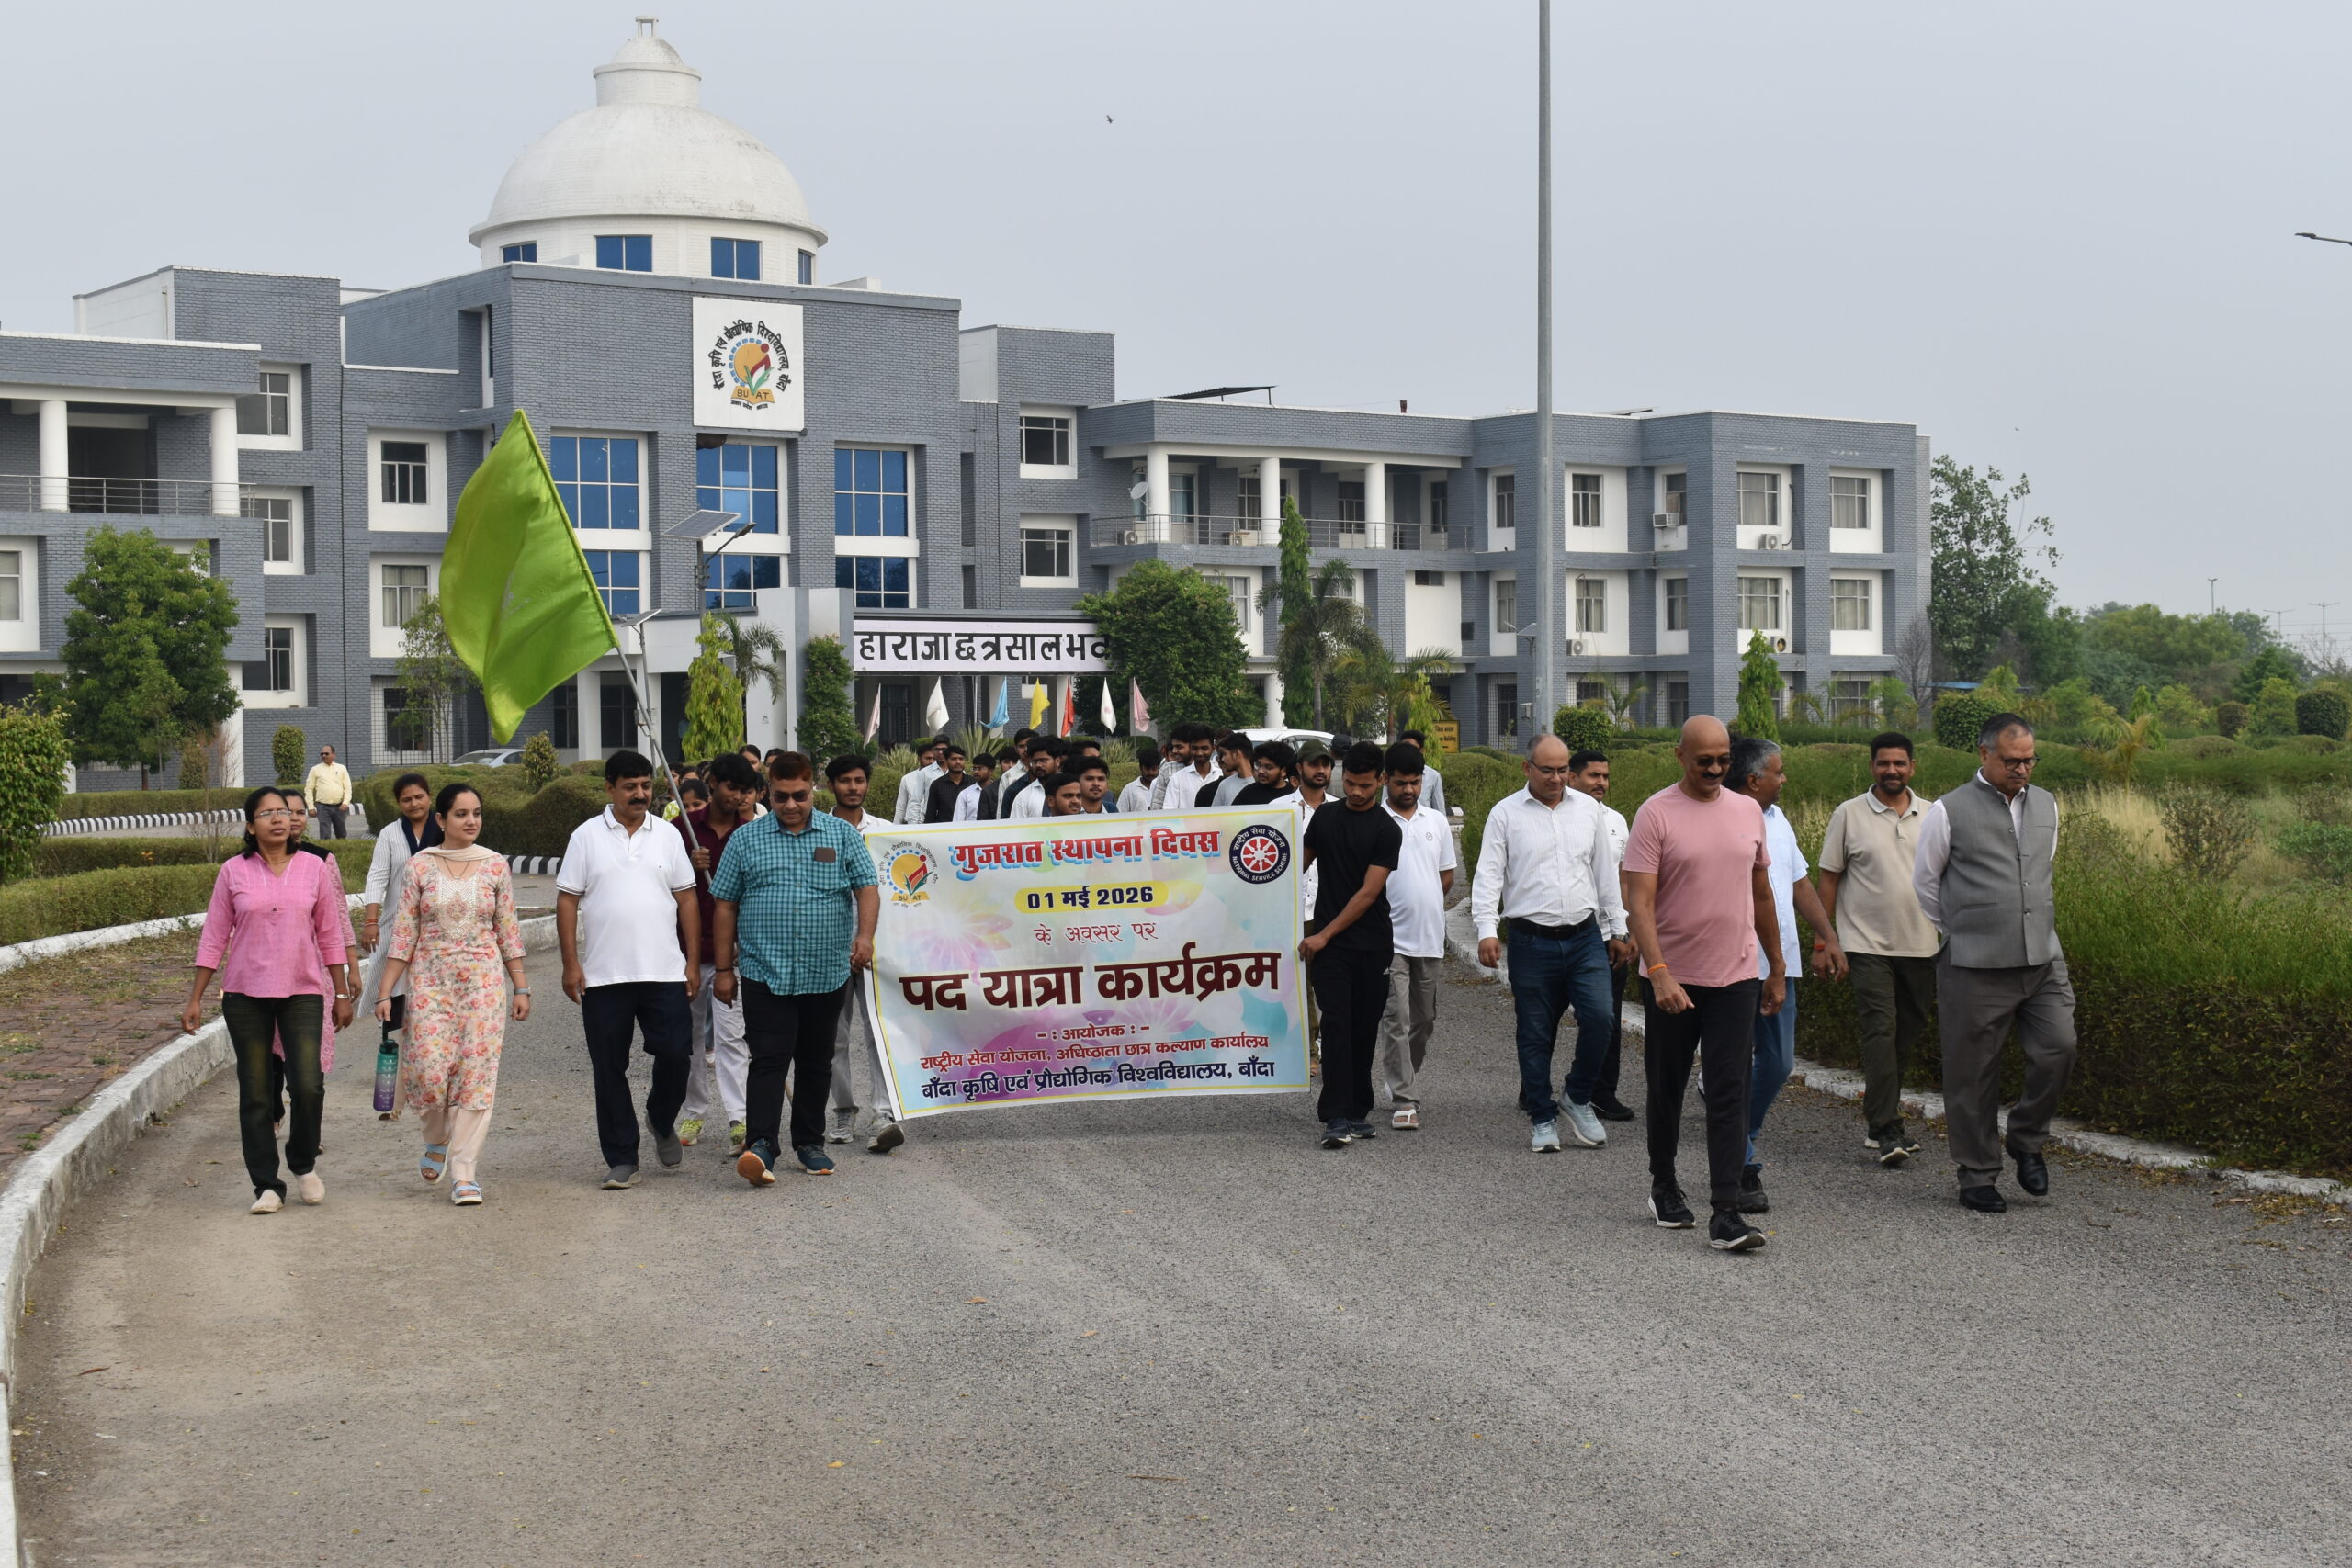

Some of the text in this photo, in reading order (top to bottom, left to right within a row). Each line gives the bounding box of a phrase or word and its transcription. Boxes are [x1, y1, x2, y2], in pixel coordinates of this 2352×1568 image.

[715, 336, 727, 350] एवं
[708, 349, 726, 367] कृषि
[854, 631, 1110, 661] हाराजा छत्रसाल भव
[951, 828, 1221, 878] गुजरात स्थापना दिवस
[1233, 831, 1250, 850] राष्ट्रीय
[1268, 830, 1286, 847] योजना
[1232, 852, 1287, 881] NATIONAL SERVICE SCHEME
[1027, 886, 1154, 909] 01 मई 2026
[1034, 922, 1159, 945] के अवसर पर
[899, 942, 1282, 1010] पद यात्रा कार्यक्रम
[920, 1032, 1269, 1072] राष्ट्रीय सेवा योजना, अधिष्ठाता छात्र कल्याण कार्यालय
[922, 1055, 1274, 1101] बाँदा कृषि एवं प्रौद्योगिक विश्वविद्यालय, बाँदा
